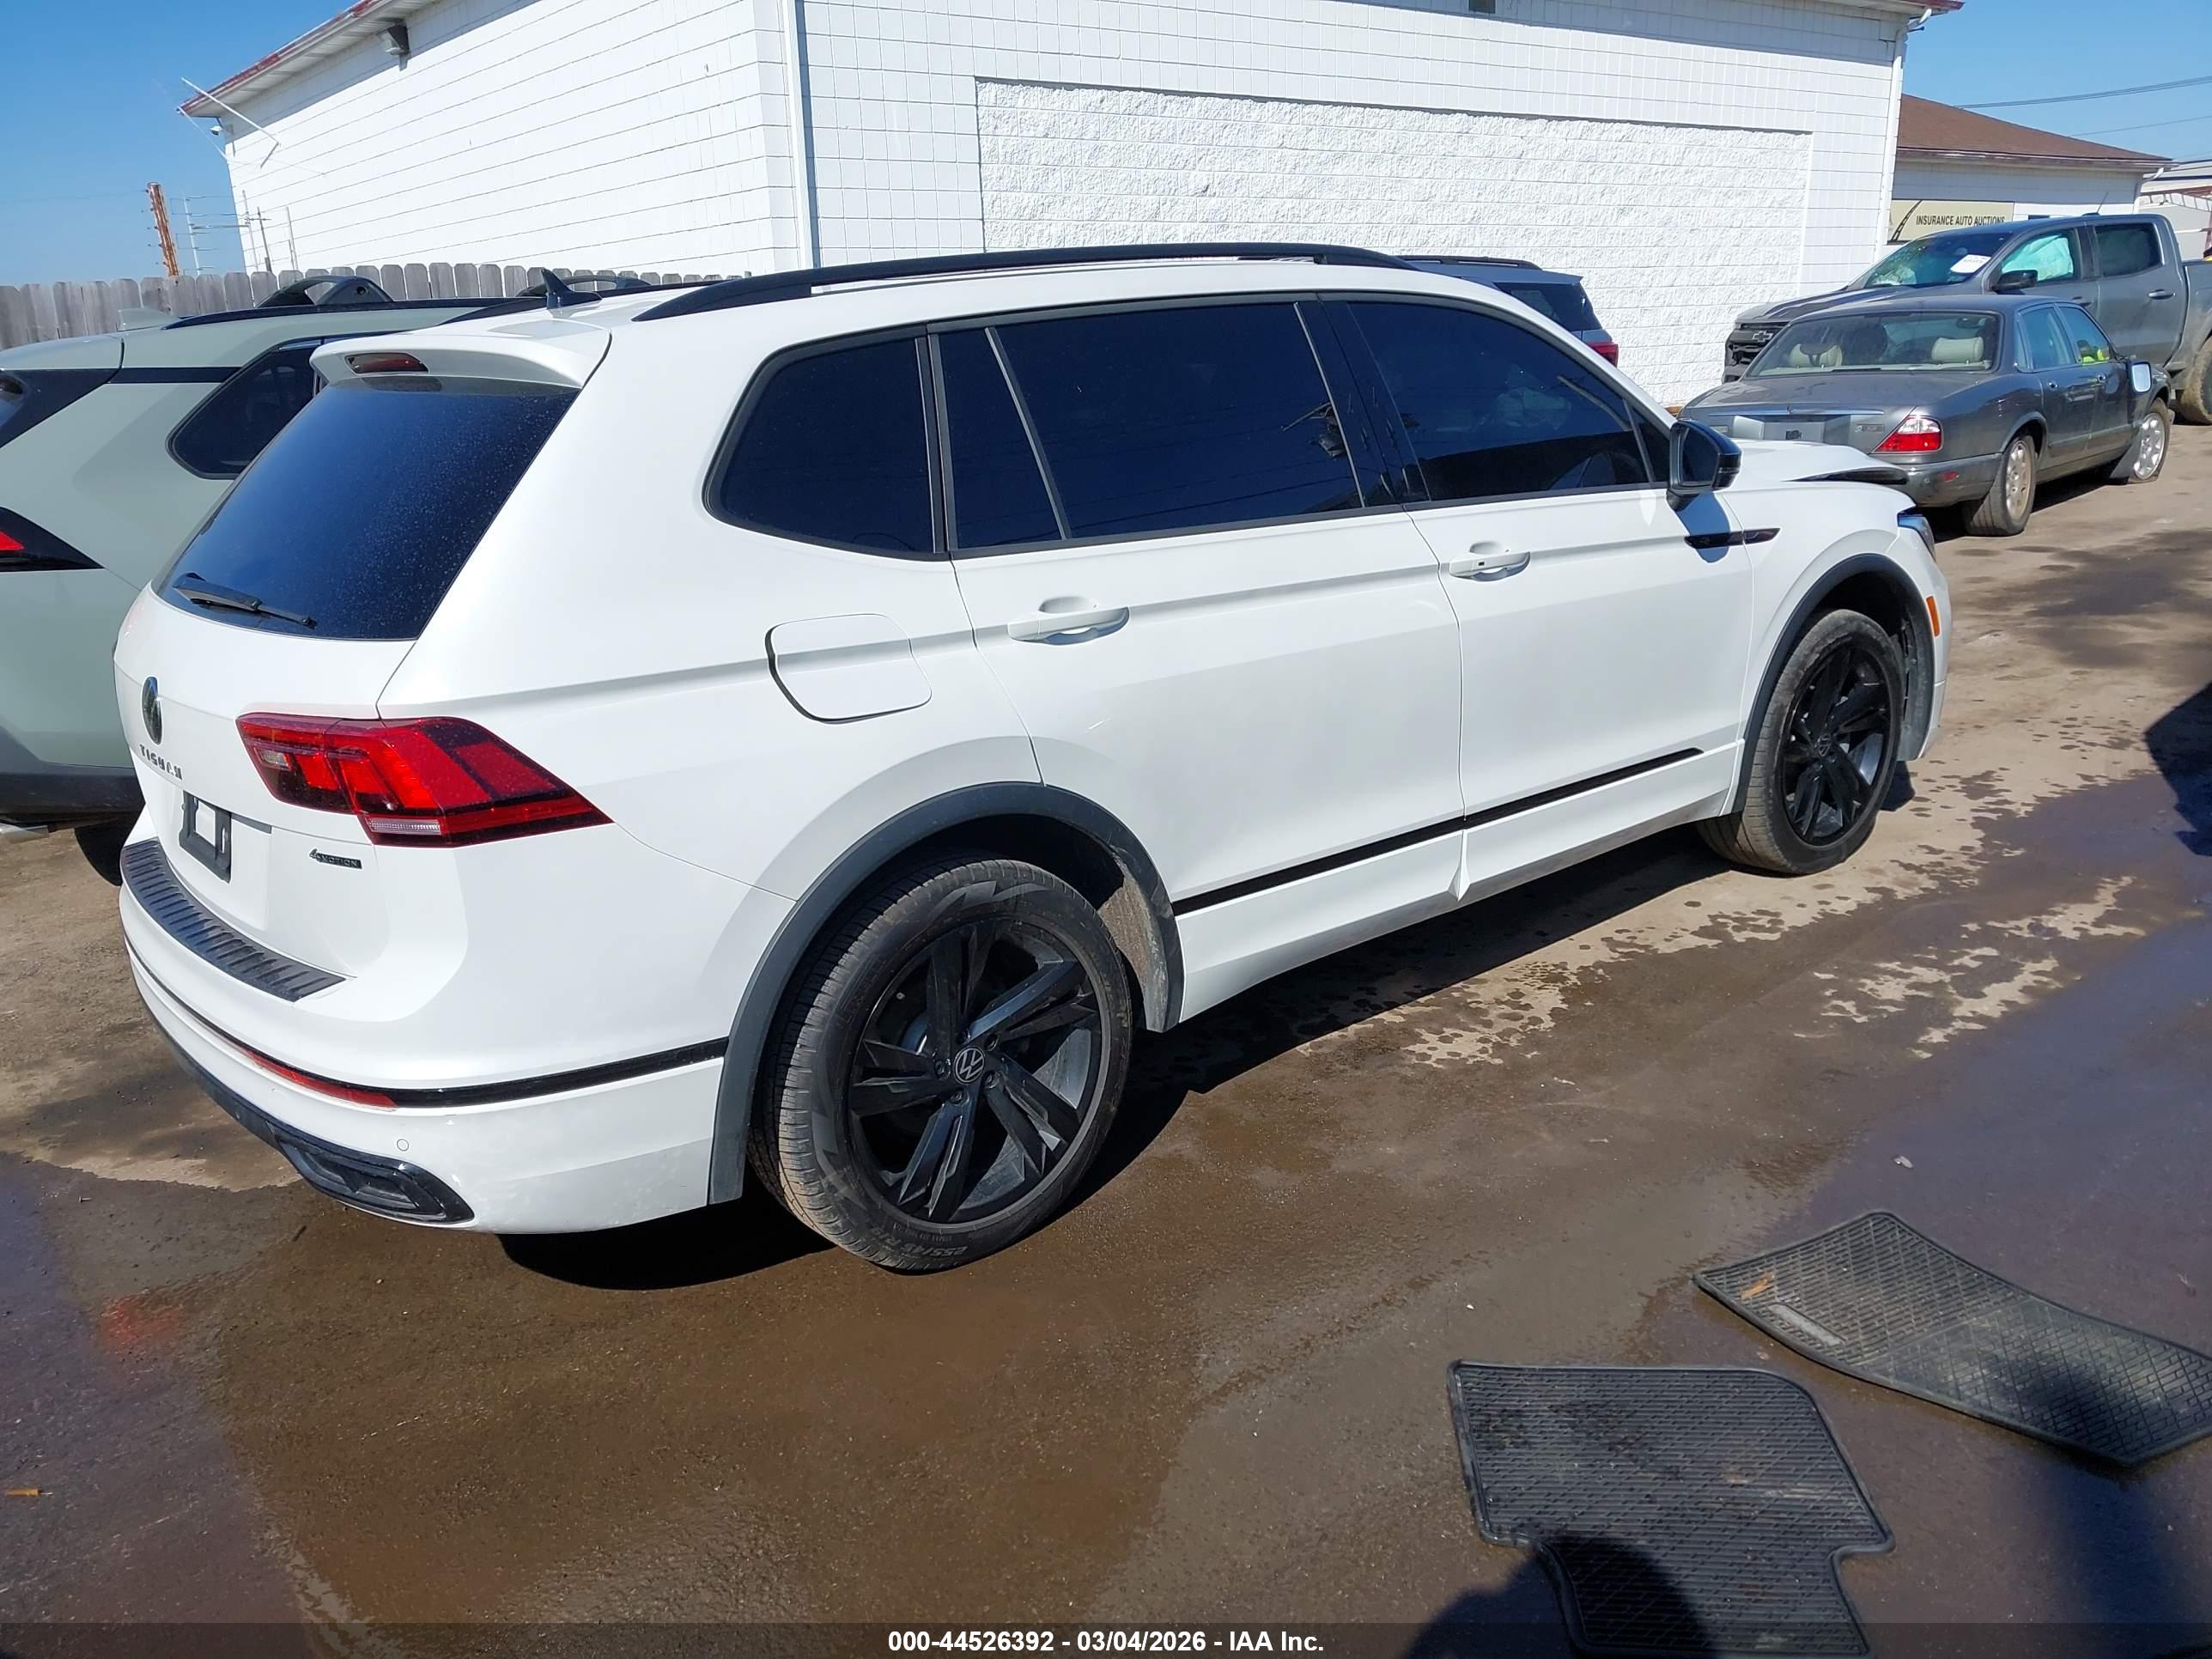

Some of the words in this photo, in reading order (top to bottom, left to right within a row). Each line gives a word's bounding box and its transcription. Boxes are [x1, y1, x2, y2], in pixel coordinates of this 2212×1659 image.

[1916, 215, 1954, 226] INSURANCE
[1955, 216, 1973, 226] AUTO
[1974, 216, 2006, 227] AUCTIONS
[139, 744, 183, 781] TIGUAN
